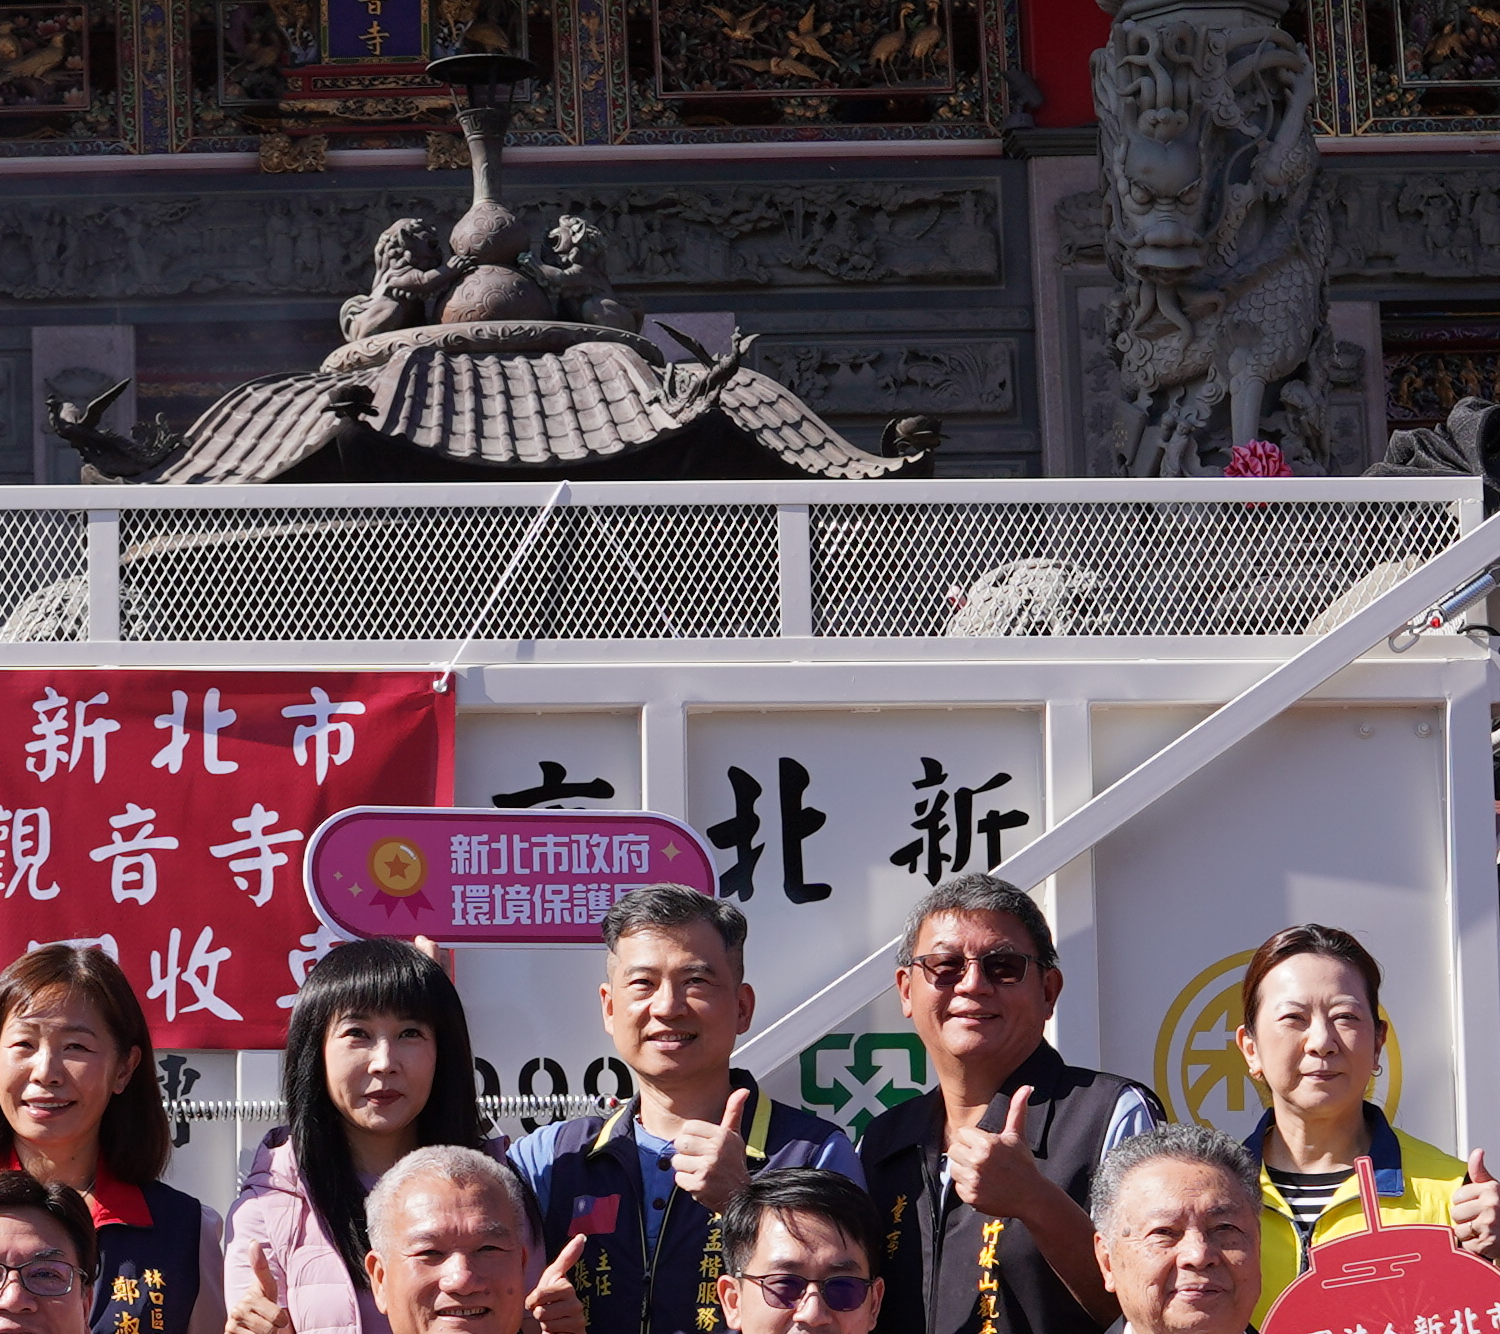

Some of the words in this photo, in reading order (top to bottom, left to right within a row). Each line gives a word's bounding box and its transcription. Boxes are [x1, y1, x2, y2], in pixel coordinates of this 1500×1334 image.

[450, 832, 652, 876] 新北市政府
[596, 1248, 612, 1297] 主任
